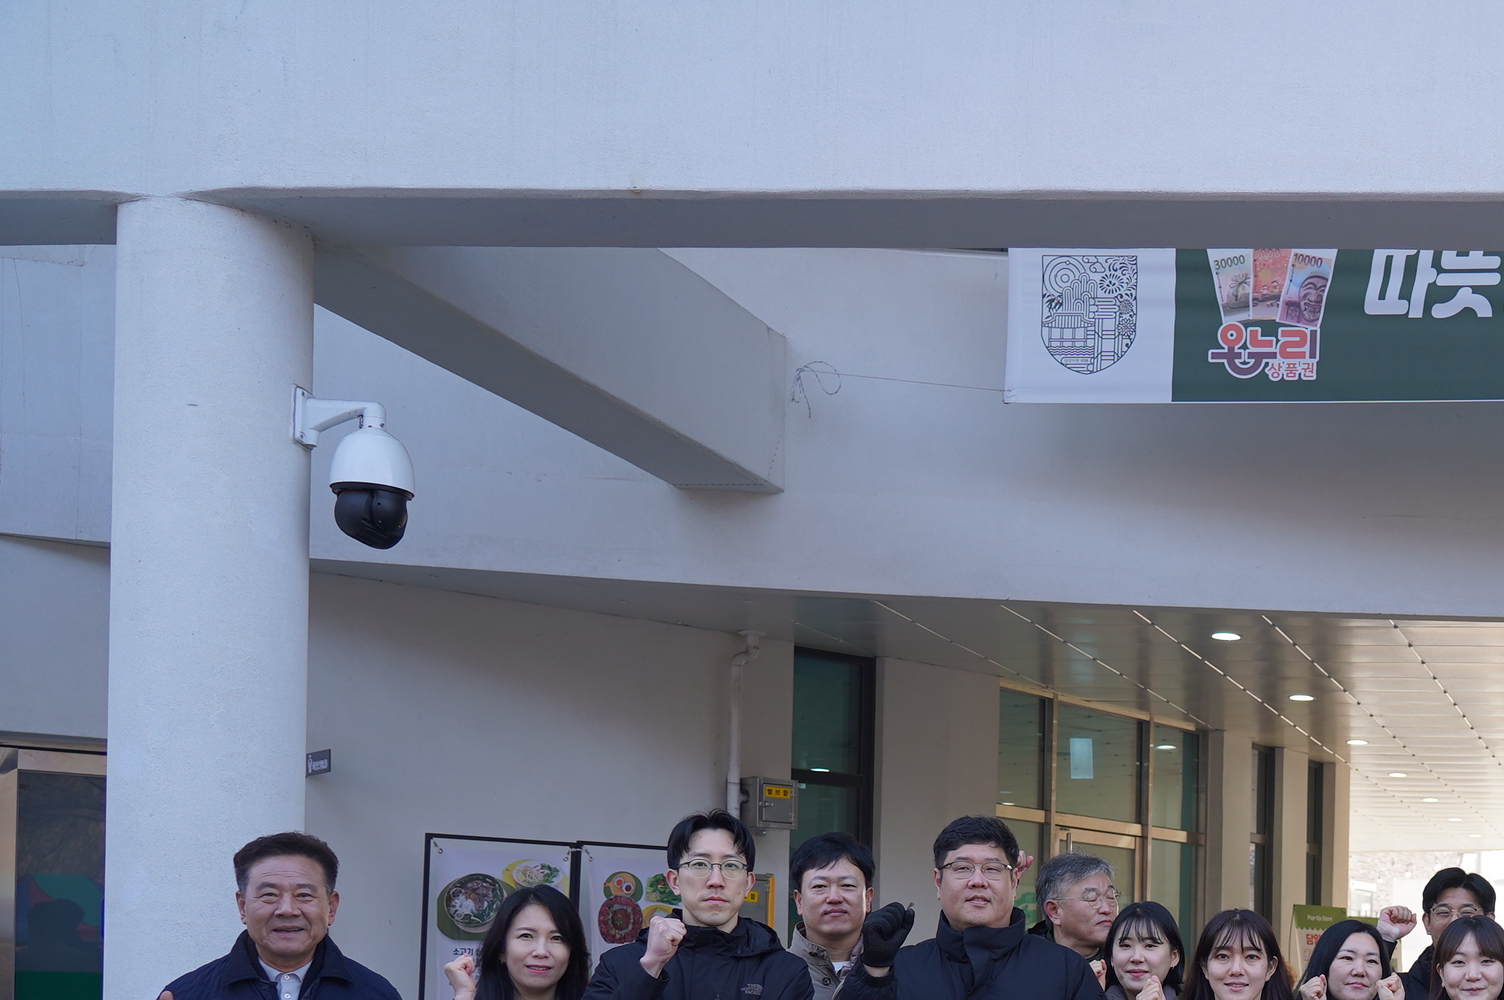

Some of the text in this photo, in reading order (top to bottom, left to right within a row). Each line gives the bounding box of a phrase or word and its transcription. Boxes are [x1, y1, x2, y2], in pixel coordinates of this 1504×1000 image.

[1214, 254, 1246, 271] 30000
[1293, 253, 1323, 269] 10000
[1267, 362, 1315, 379] 상품권
